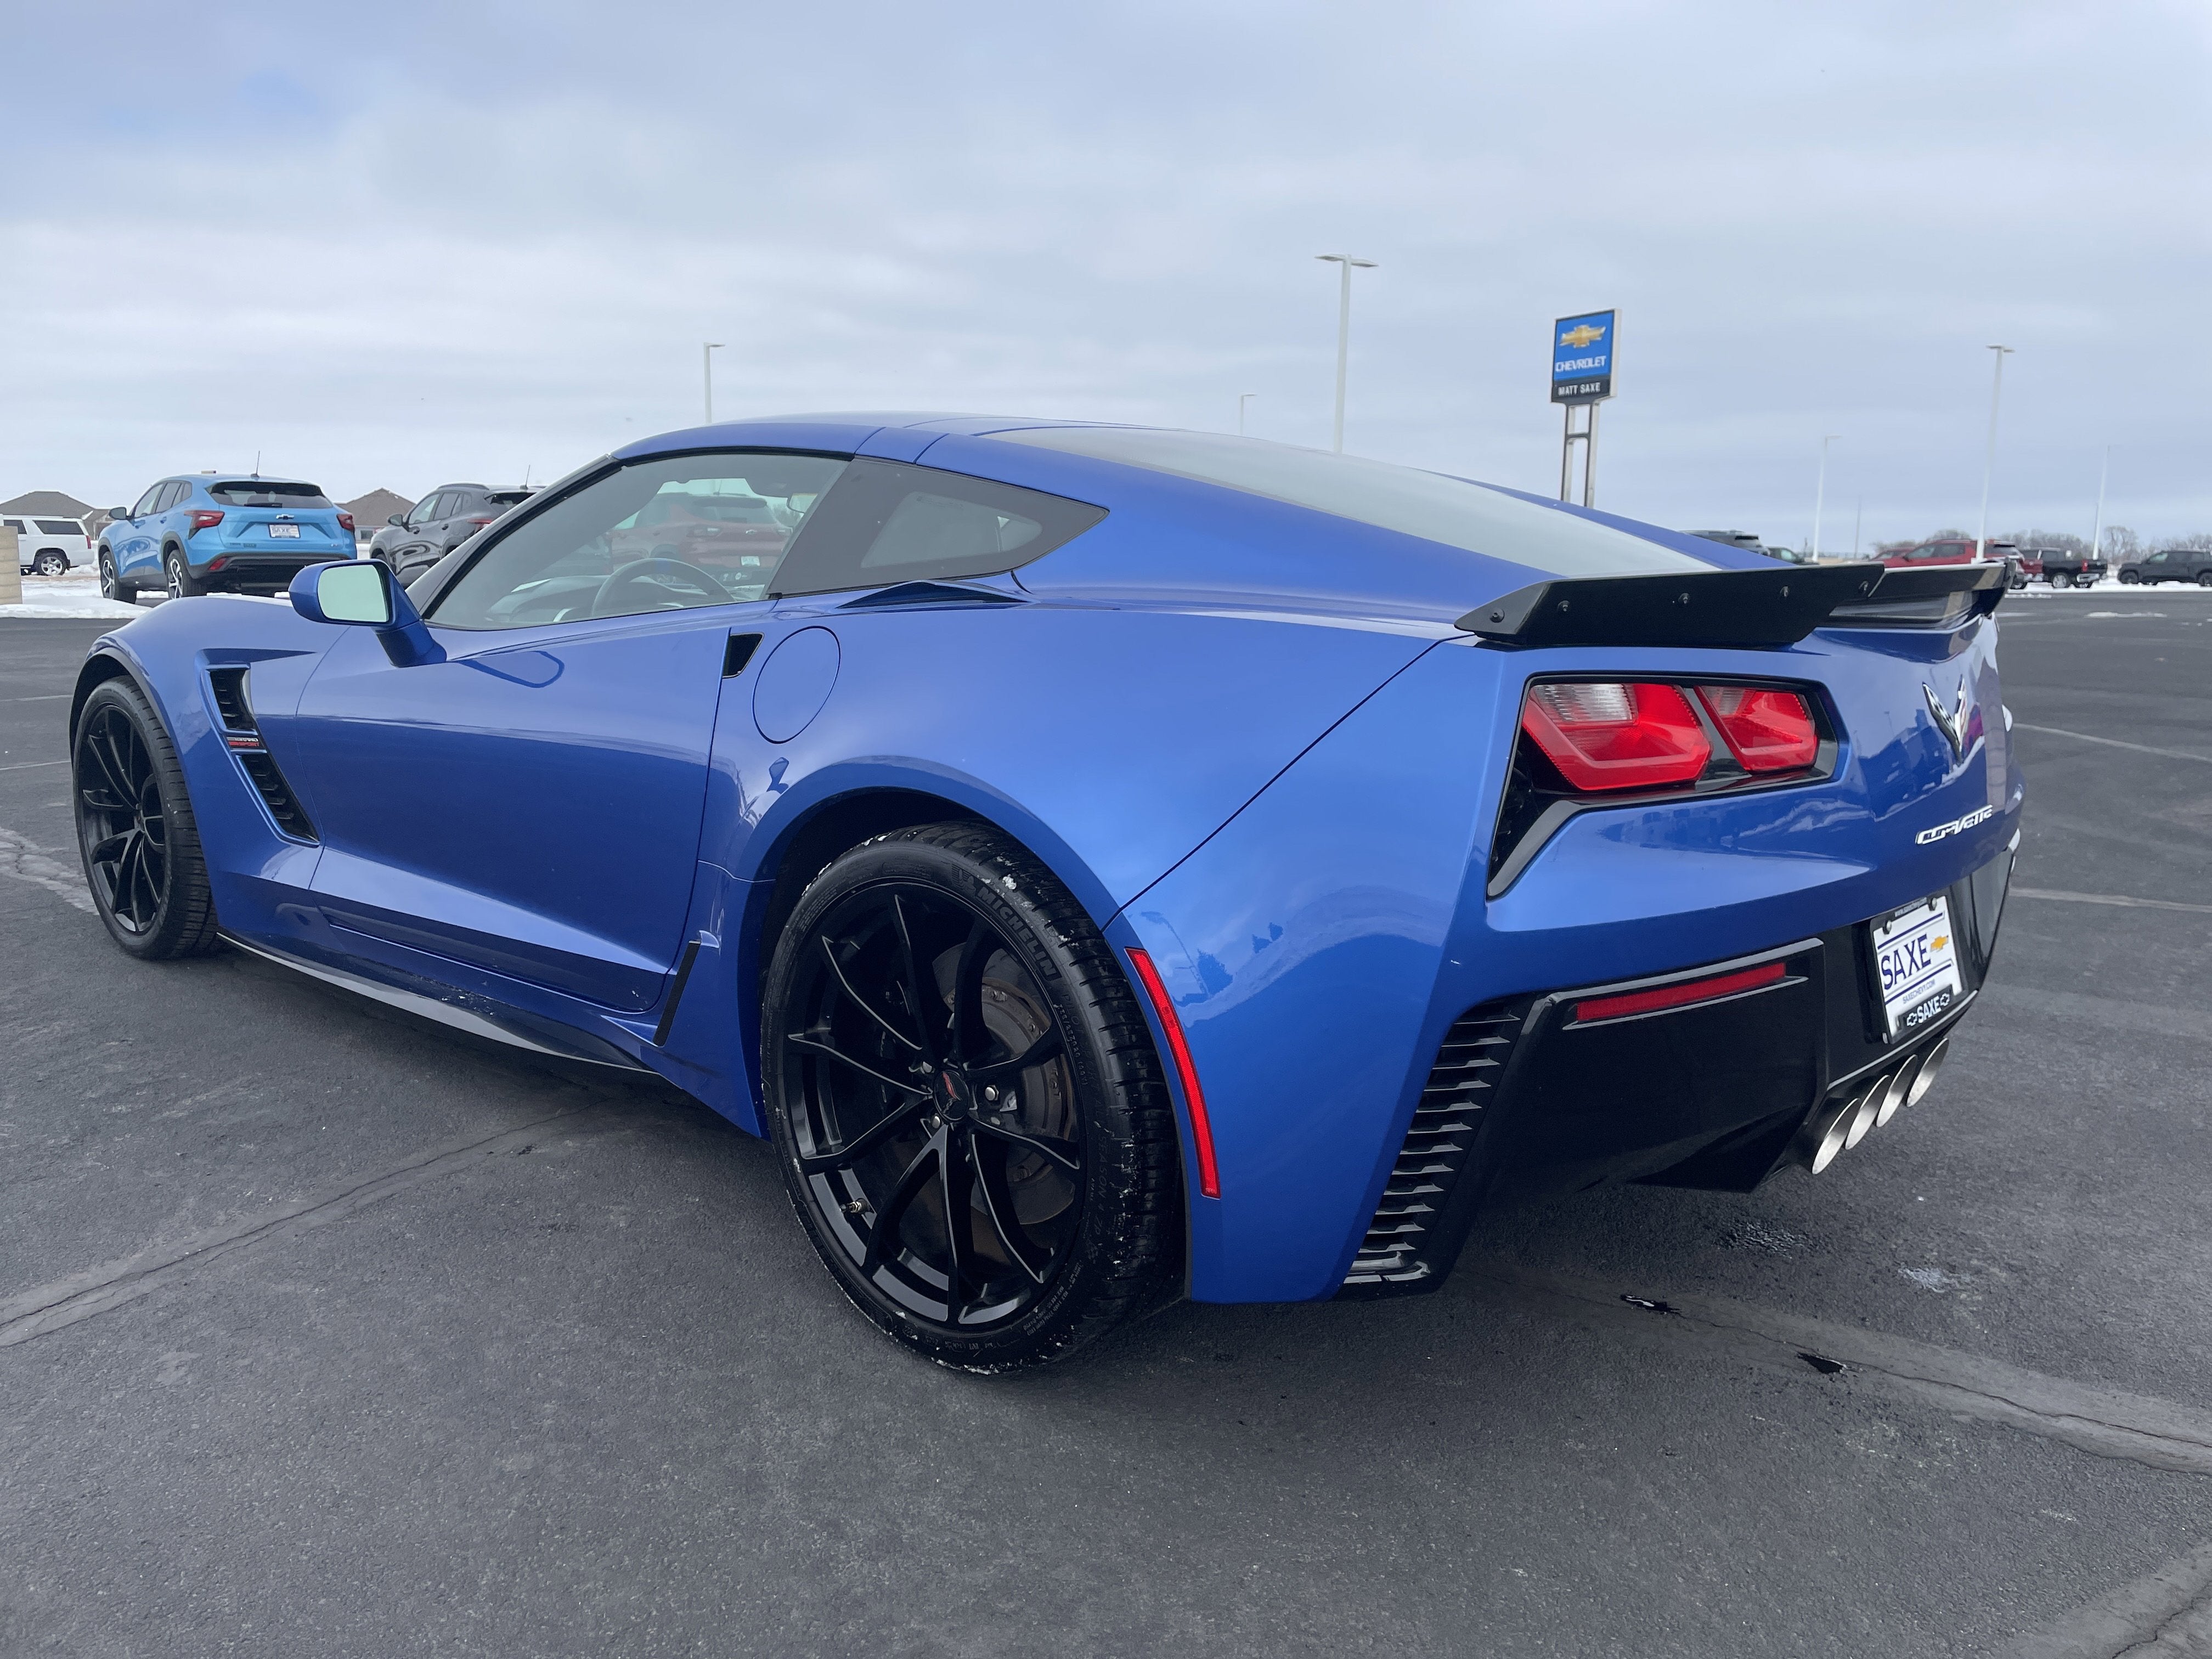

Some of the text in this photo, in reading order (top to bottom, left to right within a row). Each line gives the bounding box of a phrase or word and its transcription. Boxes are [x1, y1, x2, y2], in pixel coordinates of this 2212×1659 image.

[1555, 356, 1606, 372] CHEVROLET
[1558, 382, 1600, 396] MATT SAXE
[1915, 804, 1993, 845] CORVETTE
[977, 885, 1058, 977] MICHELIN
[1881, 933, 1931, 990] SAXE
[1916, 995, 1942, 1023] SAXE
